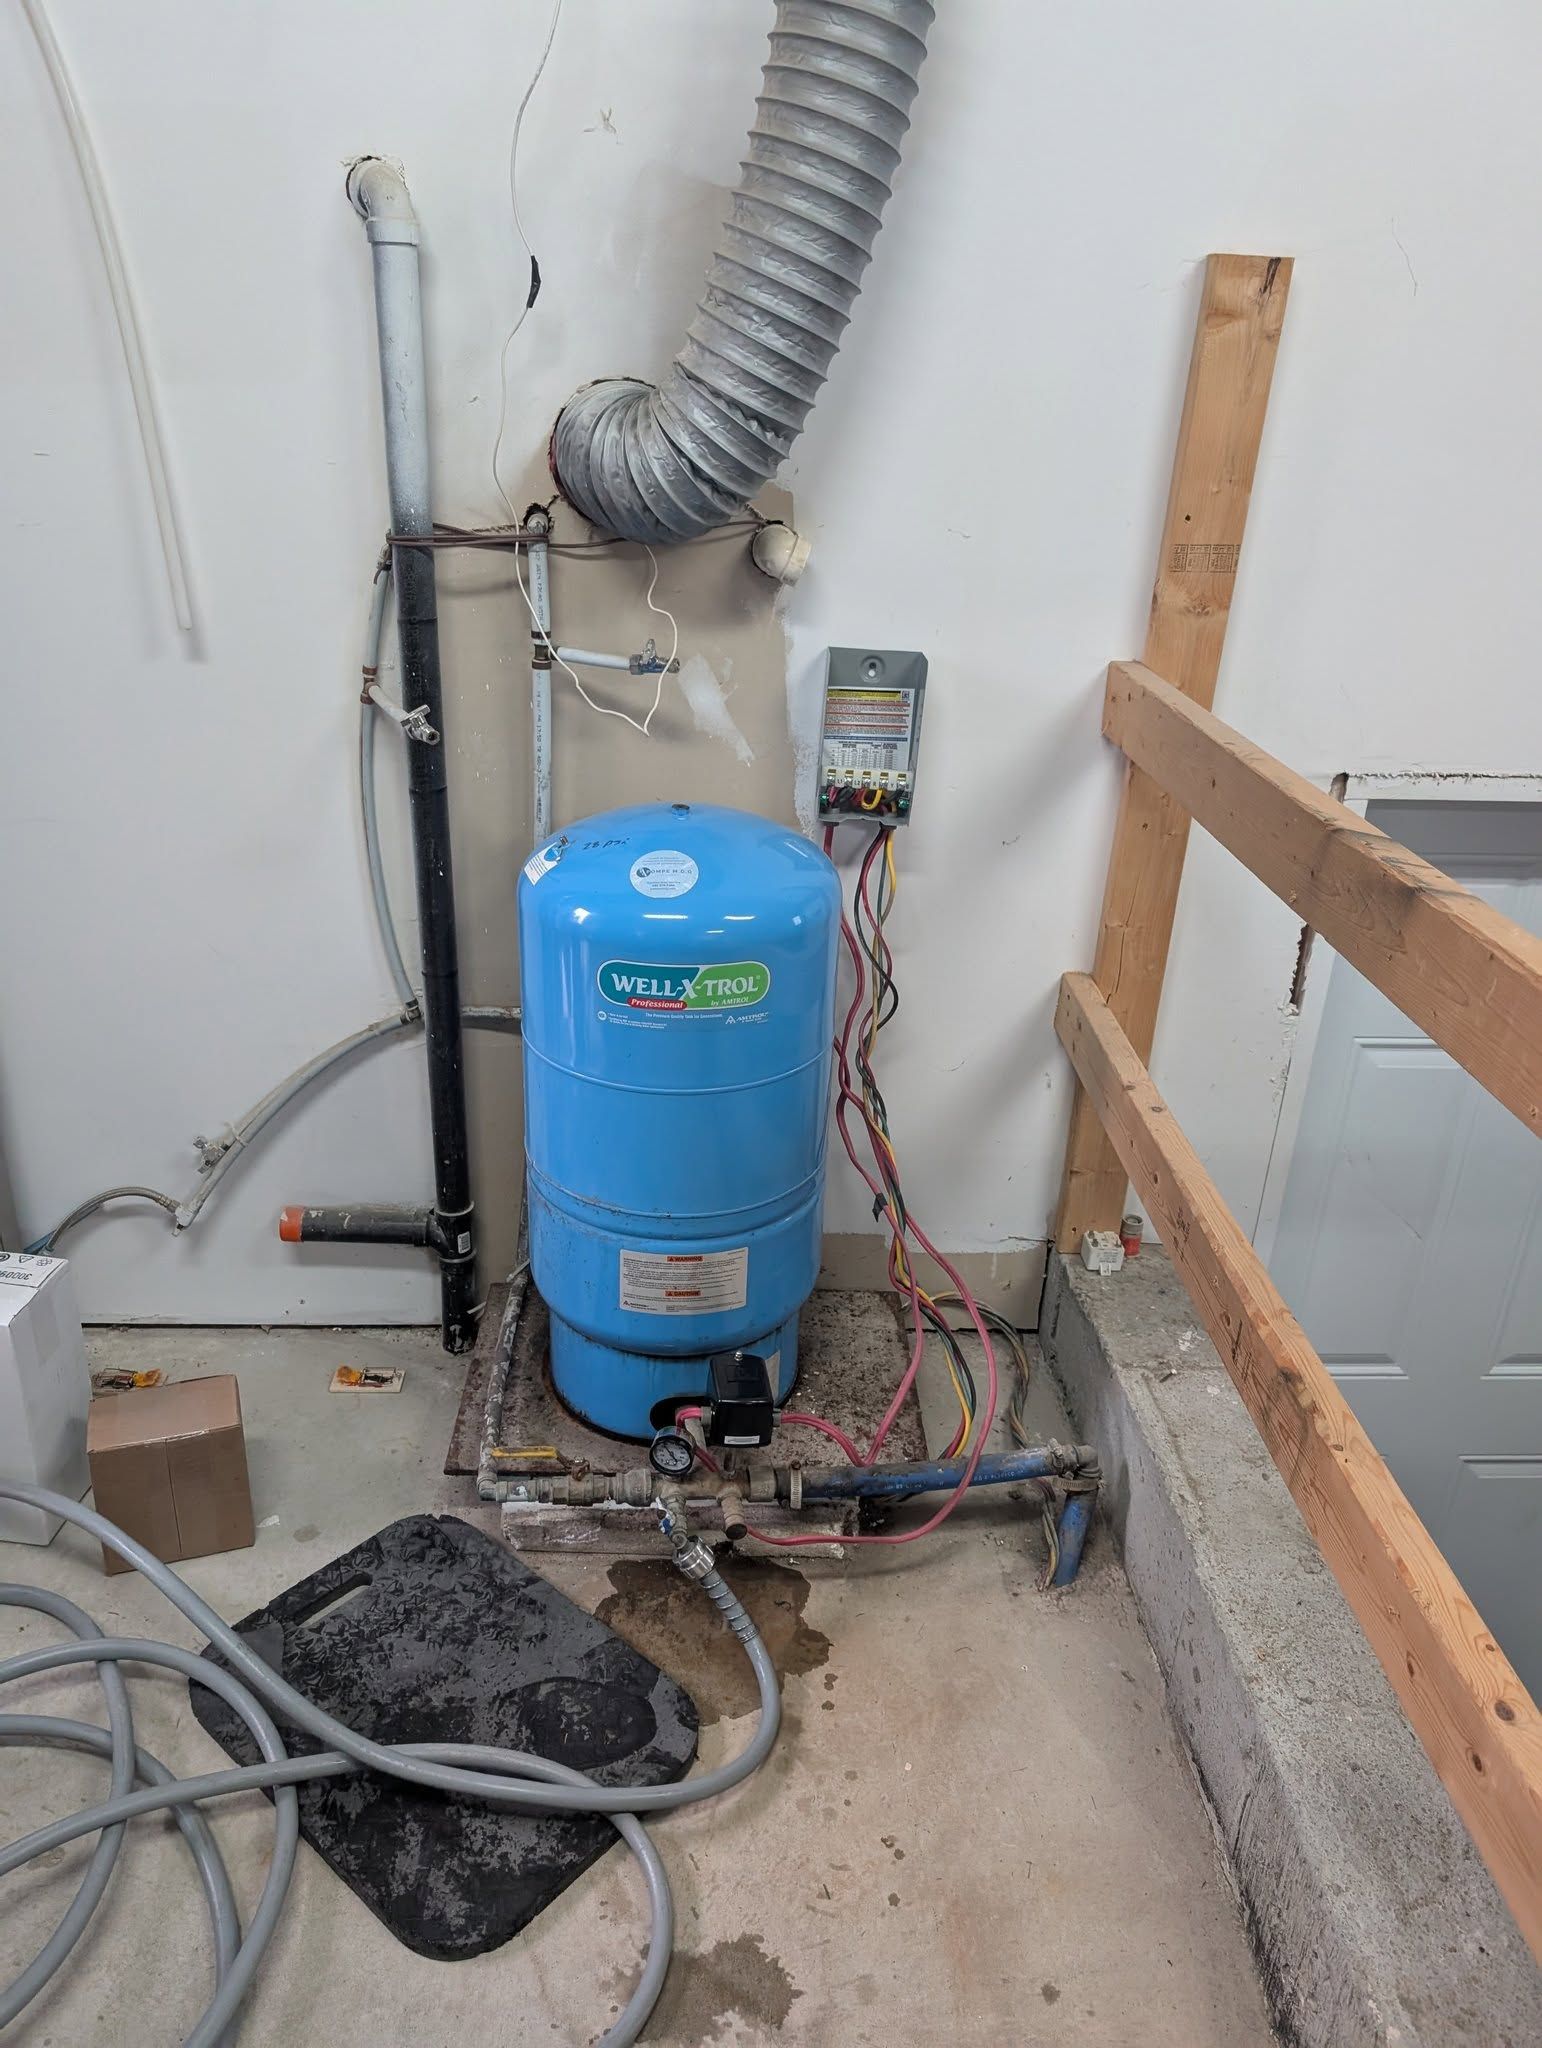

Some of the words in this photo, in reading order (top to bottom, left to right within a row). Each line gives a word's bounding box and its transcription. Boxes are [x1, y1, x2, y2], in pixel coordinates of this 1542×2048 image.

[611, 973, 759, 1001] WELL-X-TROL
[630, 998, 684, 1009] Professional
[710, 1000, 719, 1008] by
[721, 996, 749, 1005] AMTROL
